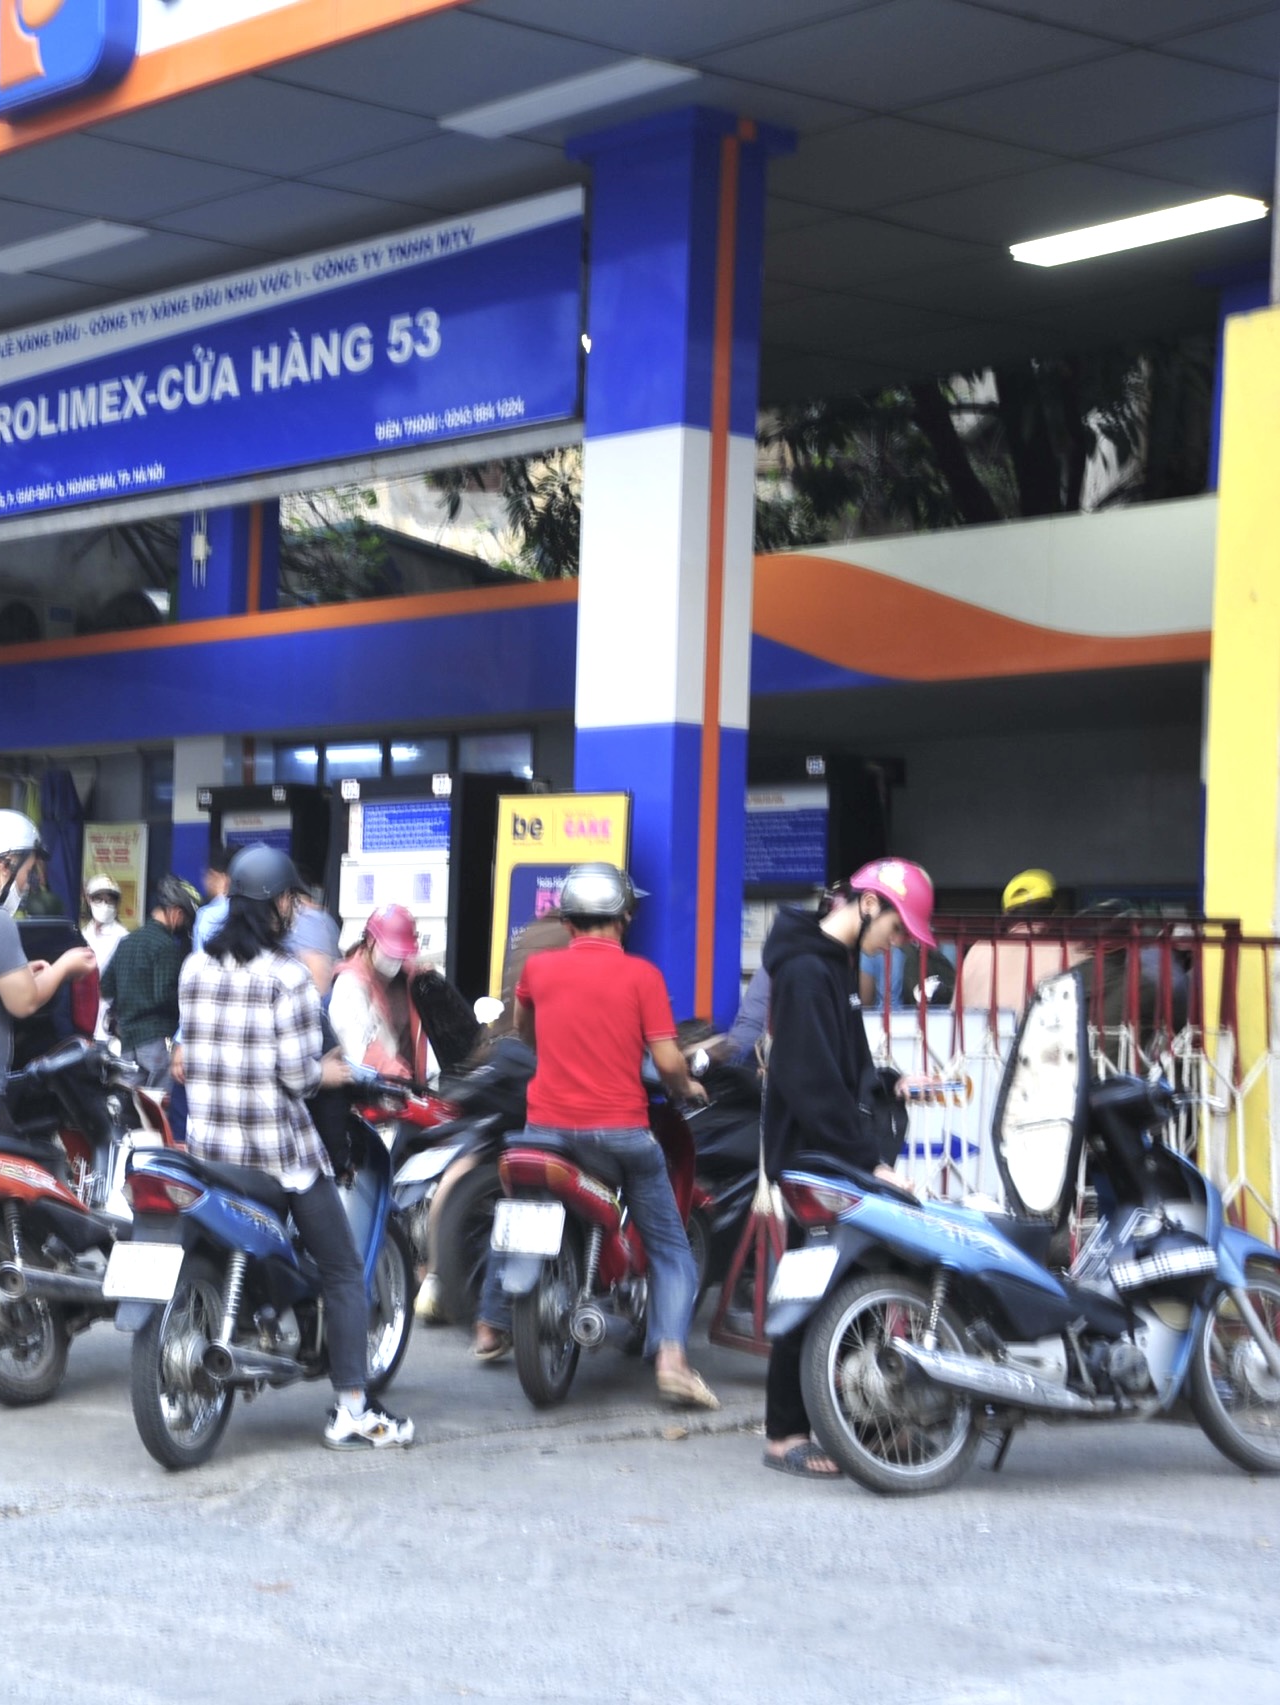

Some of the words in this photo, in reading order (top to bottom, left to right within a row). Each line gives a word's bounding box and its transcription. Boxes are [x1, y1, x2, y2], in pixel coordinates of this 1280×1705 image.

[89, 311, 128, 338] CÔNG
[311, 252, 358, 281] CÔNG
[435, 226, 475, 252] MTV
[250, 324, 374, 393] HÀNG
[385, 307, 442, 364] 53
[512, 810, 544, 842] be
[563, 818, 613, 841] CARE
